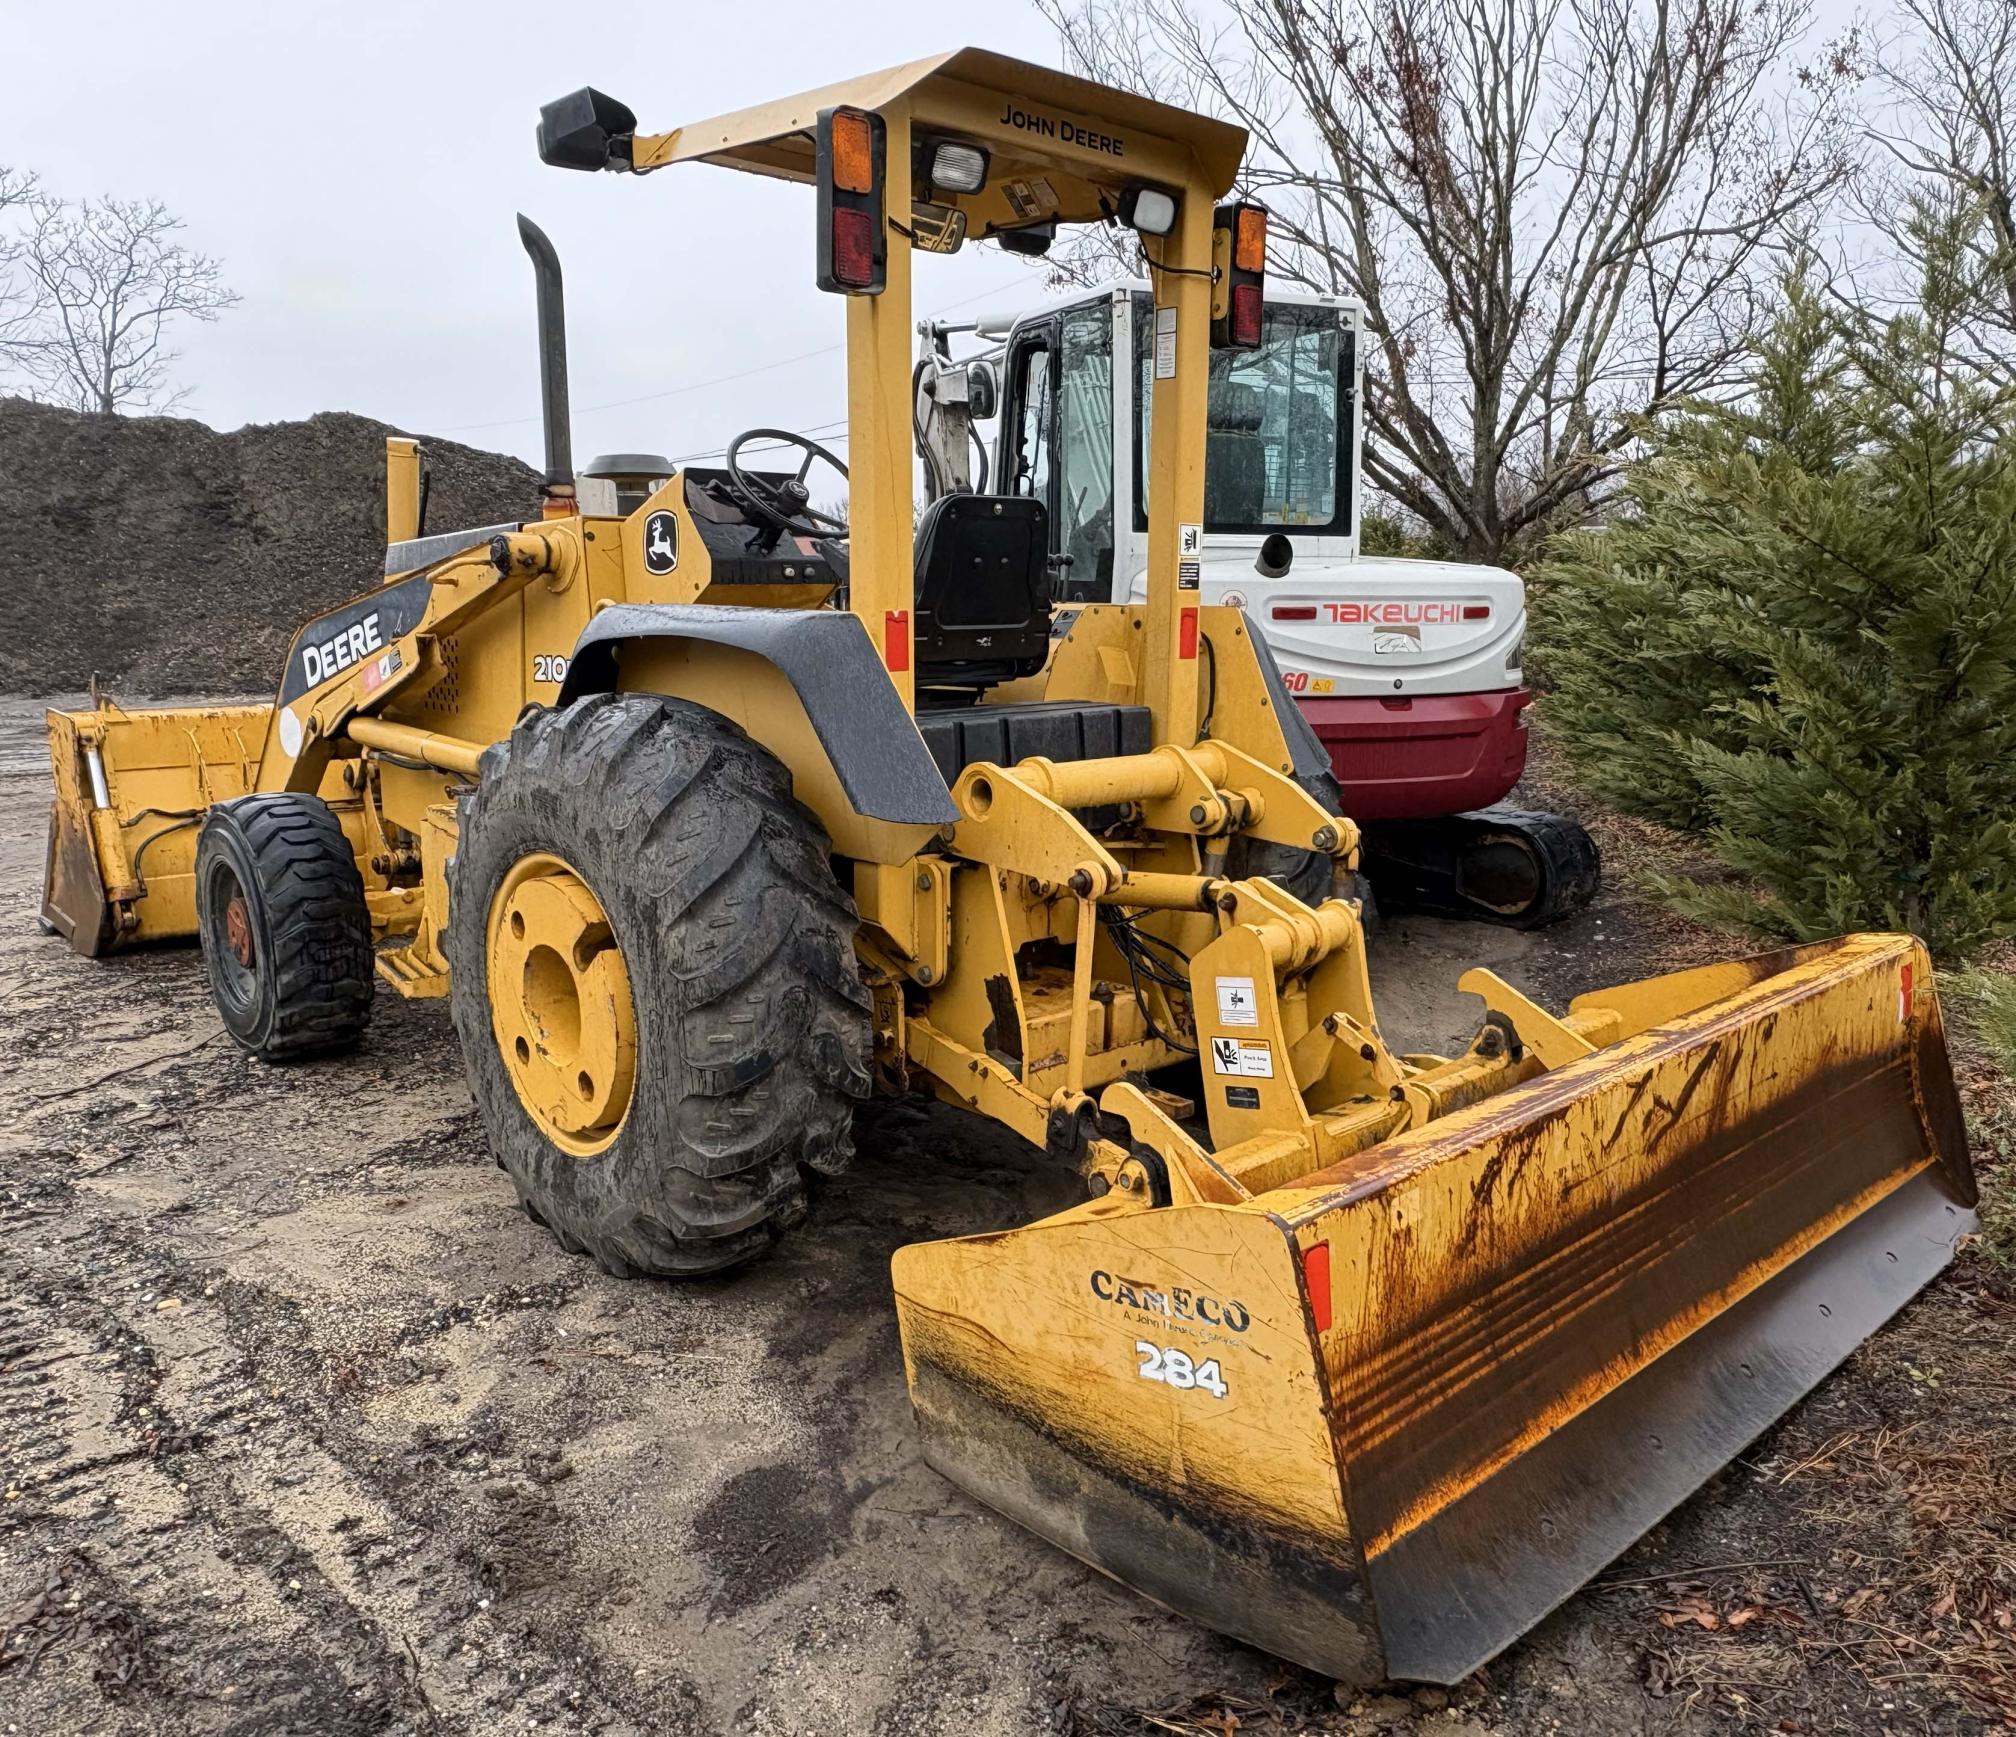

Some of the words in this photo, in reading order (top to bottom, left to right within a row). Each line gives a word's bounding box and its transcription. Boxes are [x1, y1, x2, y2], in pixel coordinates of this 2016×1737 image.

[1000, 104, 1055, 138] JOHN
[1060, 120, 1124, 157] DEERE
[302, 609, 383, 689] DEERE
[1090, 1270, 1250, 1333] CAMECO
[1136, 1312, 1160, 1329] John
[1135, 1339, 1229, 1399] 284
